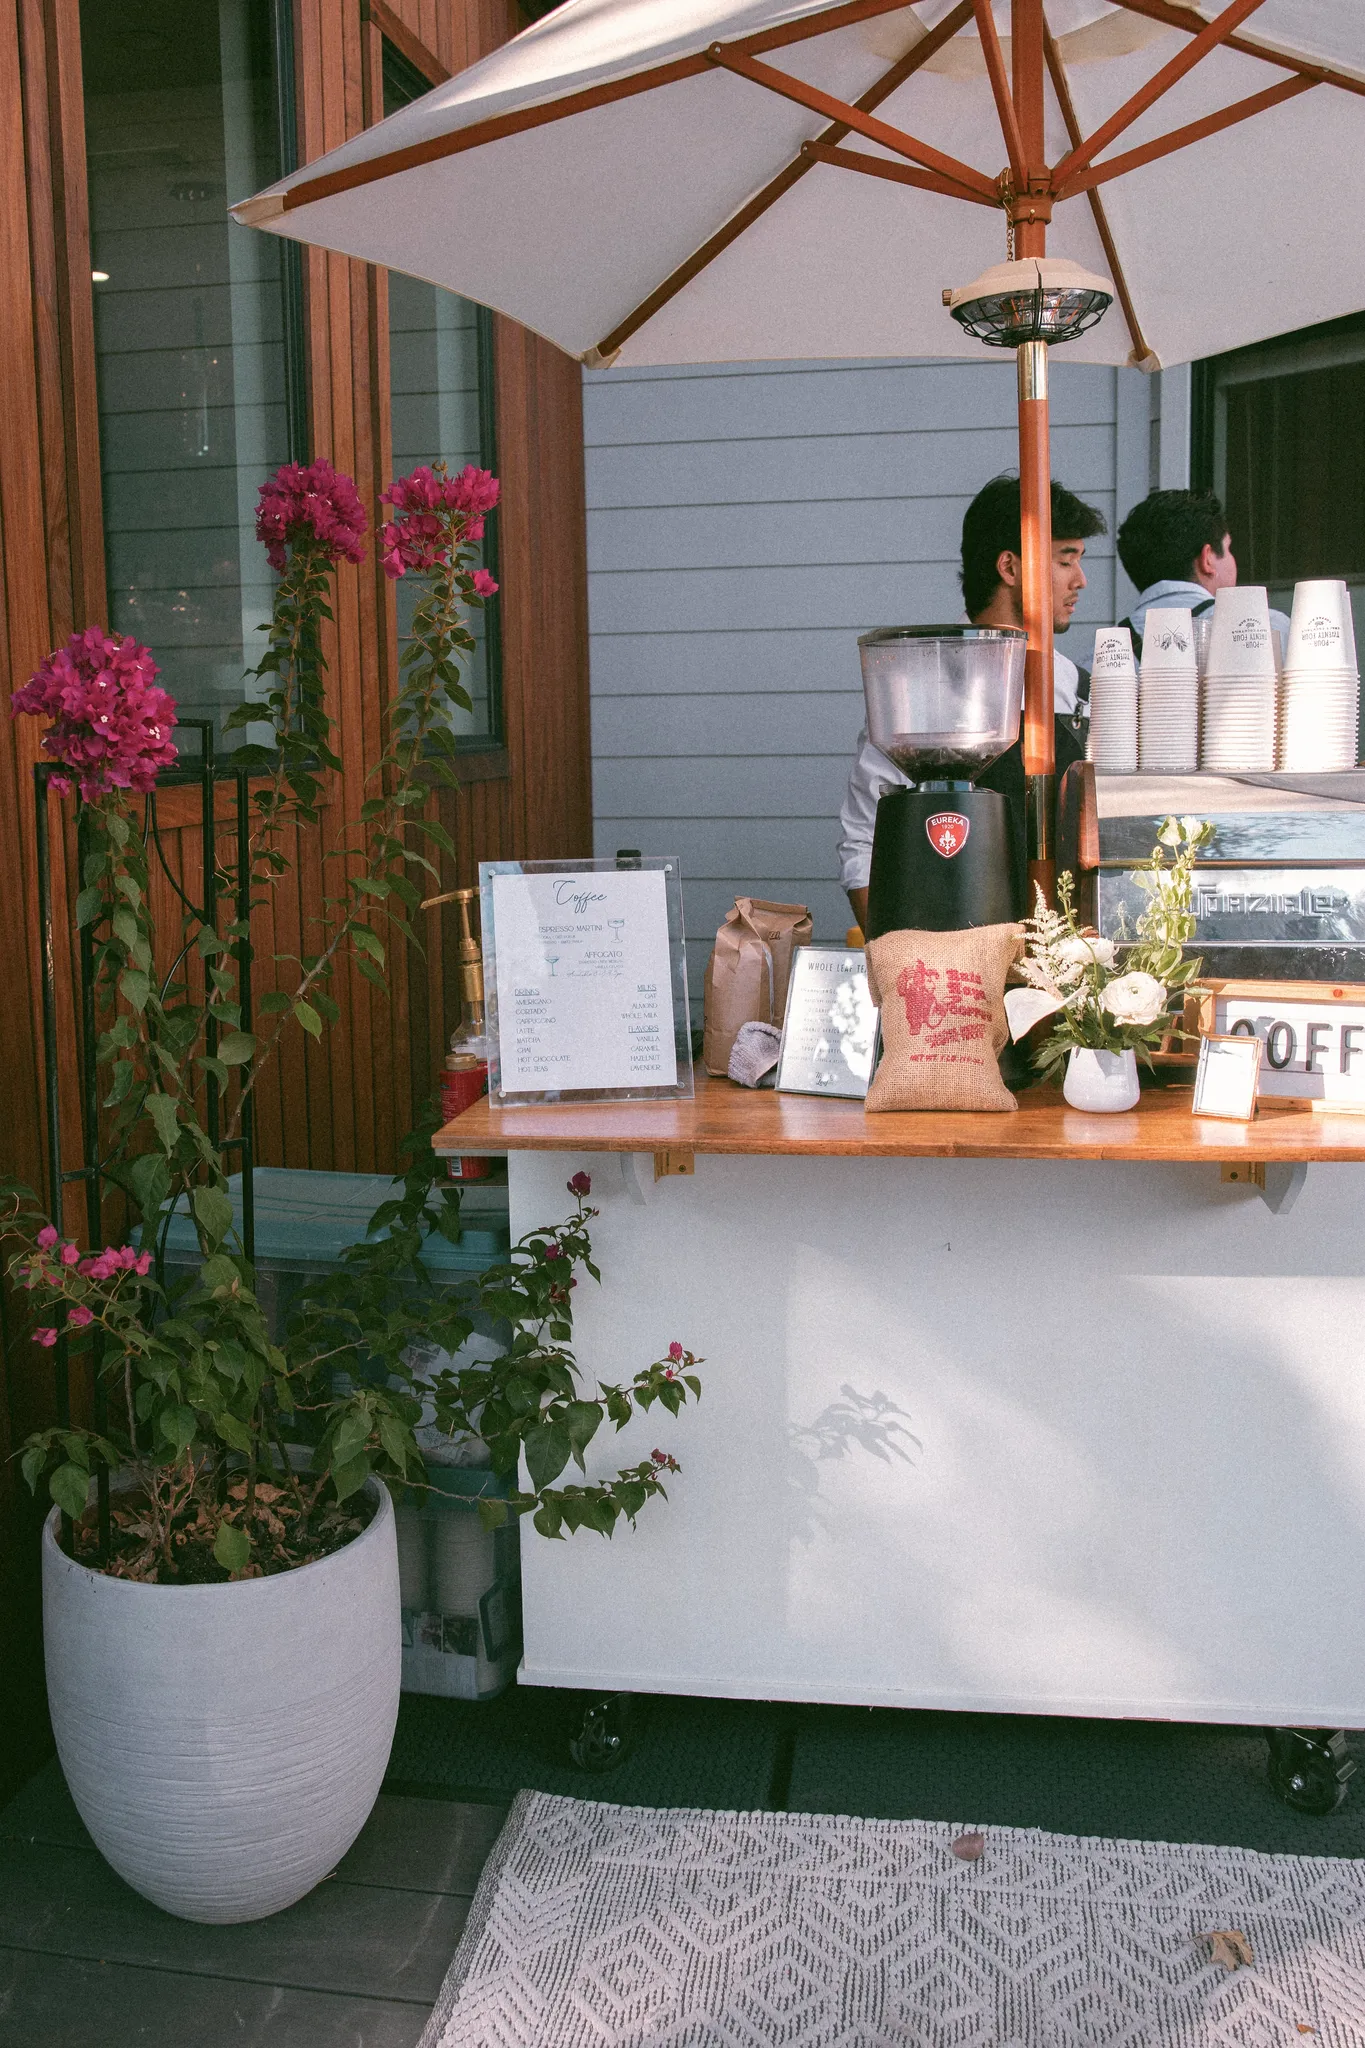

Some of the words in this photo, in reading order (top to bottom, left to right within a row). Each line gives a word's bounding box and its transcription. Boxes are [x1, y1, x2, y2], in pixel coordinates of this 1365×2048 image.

[1232, 634, 1248, 642] FOUR
[1302, 632, 1316, 640] FOUR
[1318, 631, 1340, 639] TWENTY
[1096, 655, 1108, 664] FOUR
[1110, 652, 1130, 660] TWENTY
[930, 816, 964, 826] EUREKA
[552, 880, 608, 914] Coffee
[538, 925, 574, 933] ESPRESSO
[576, 924, 603, 932] MARTINI
[584, 951, 622, 959] AFFOGATO
[808, 962, 833, 972] WHOLE
[836, 964, 852, 972] LEAF
[514, 988, 540, 996] DRINKS
[637, 984, 657, 992] MILKS
[628, 1025, 660, 1034] FLAVORS
[1230, 1018, 1364, 1074] OFF
